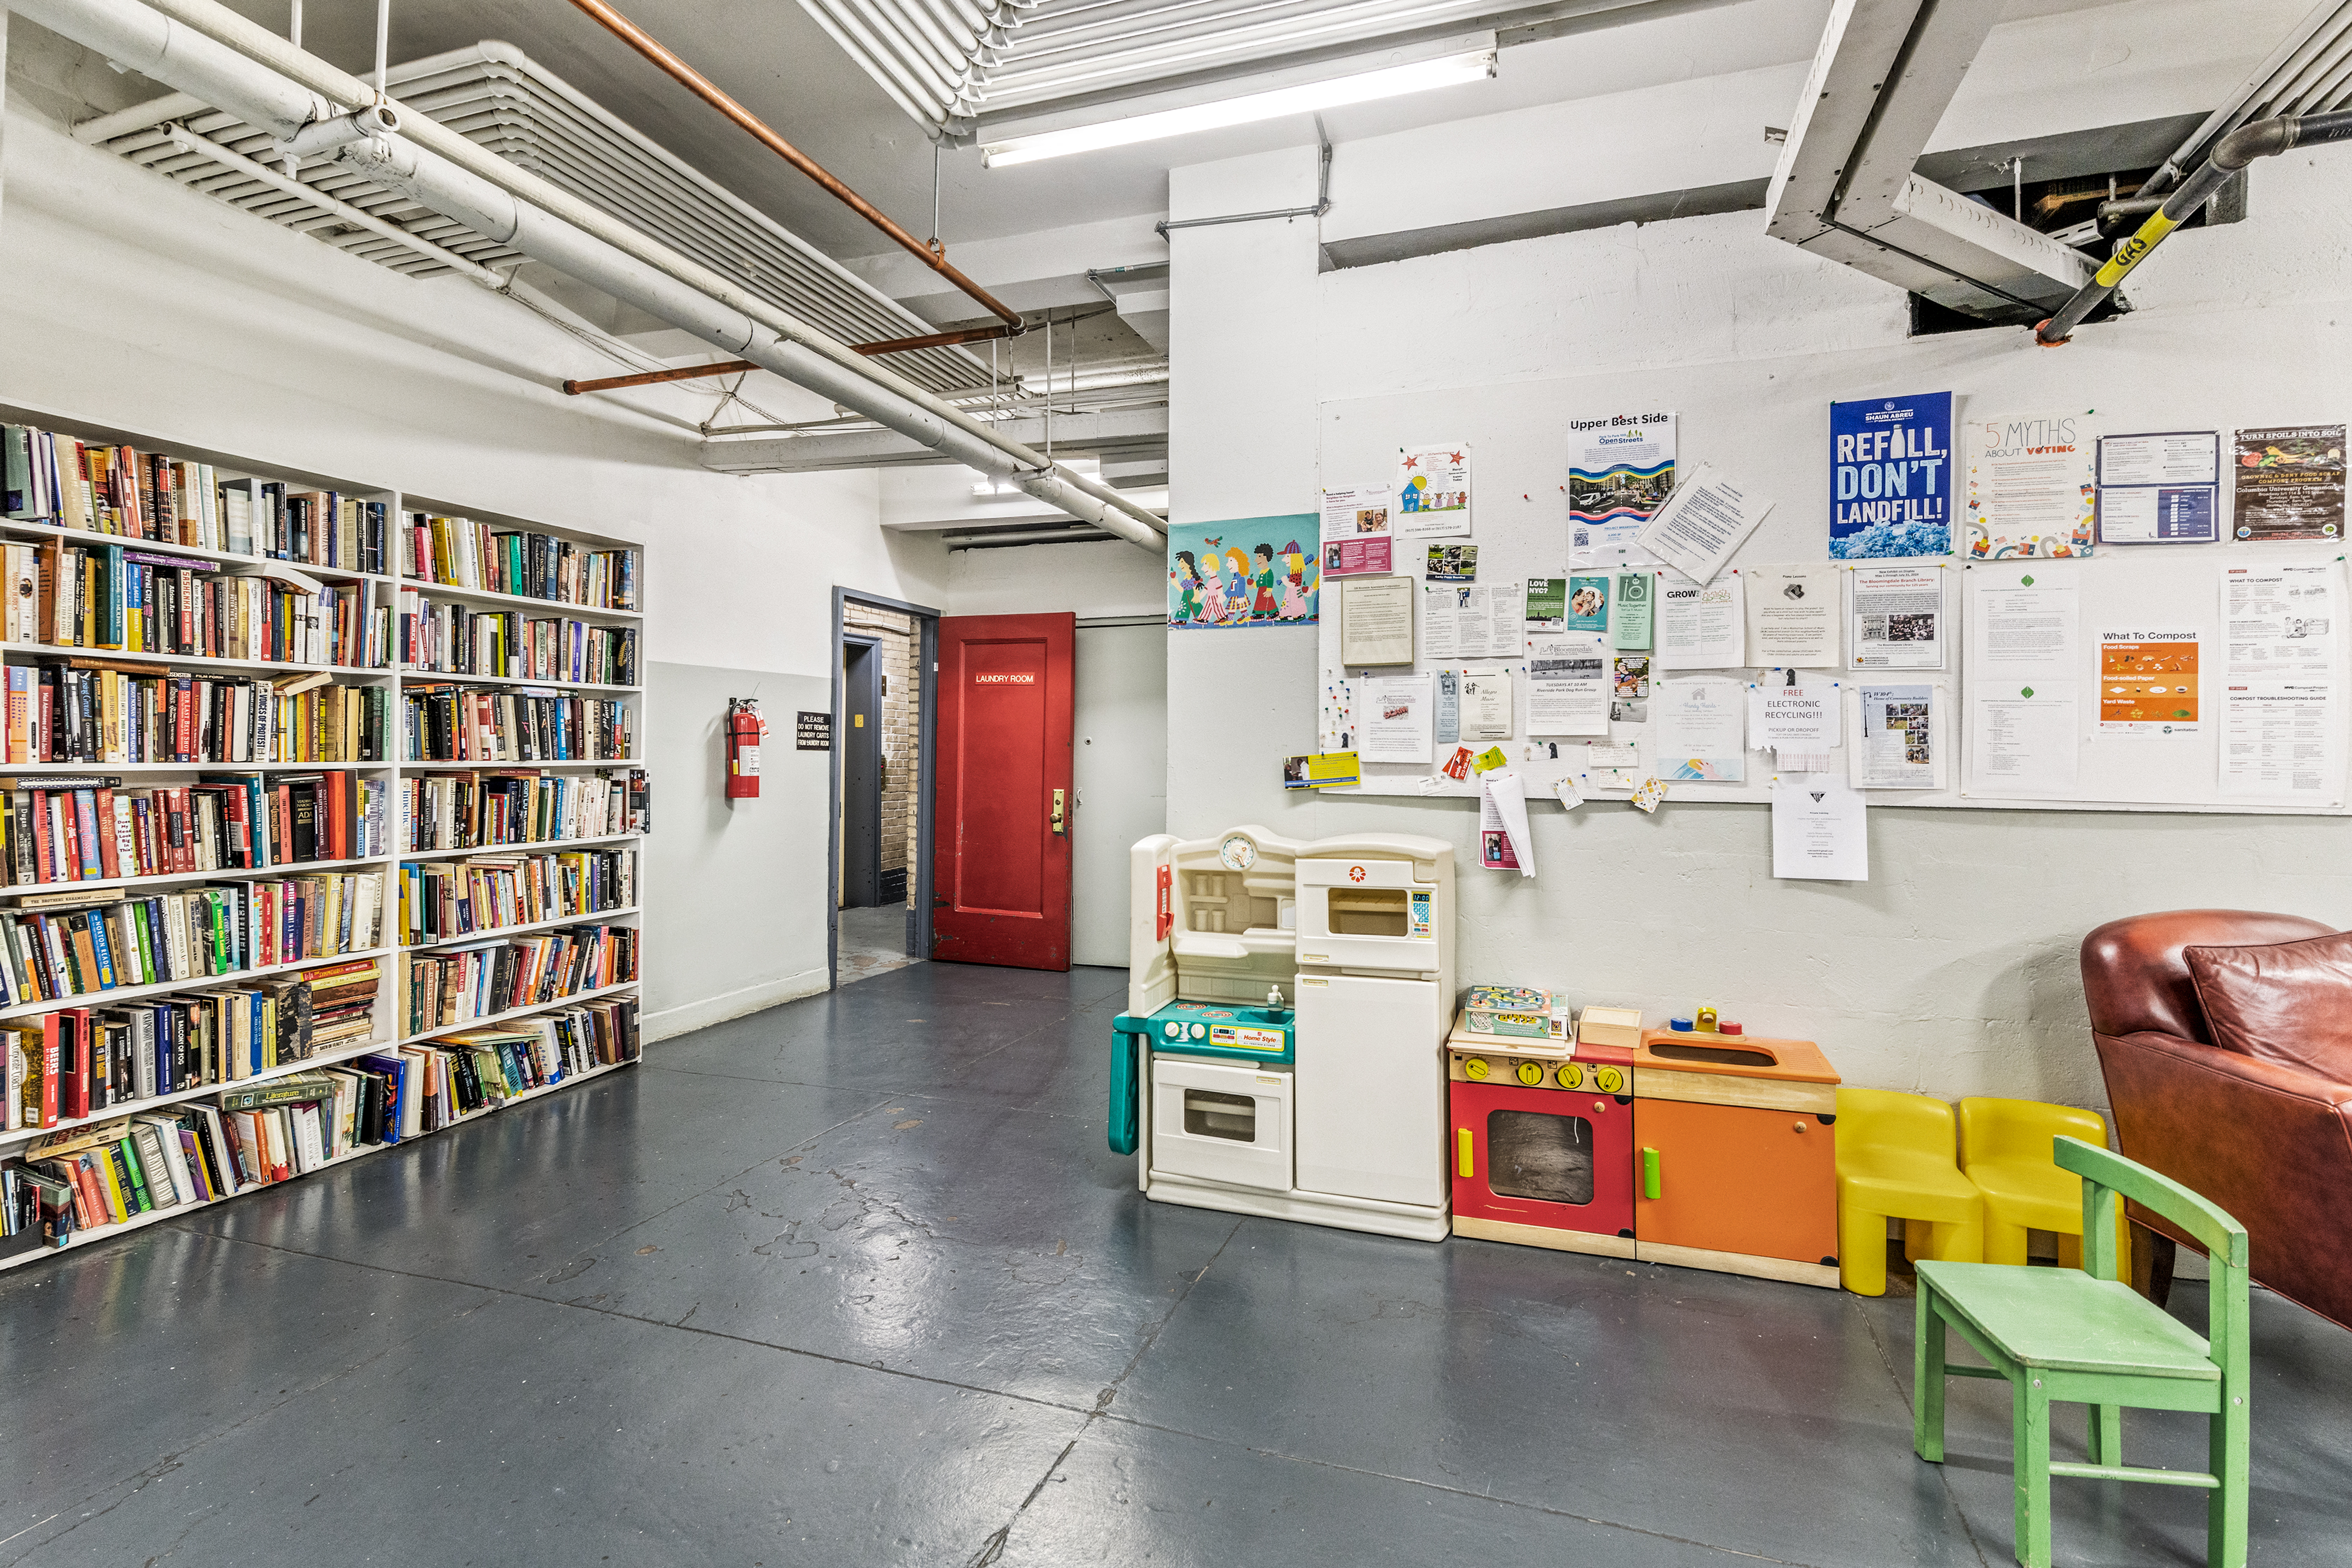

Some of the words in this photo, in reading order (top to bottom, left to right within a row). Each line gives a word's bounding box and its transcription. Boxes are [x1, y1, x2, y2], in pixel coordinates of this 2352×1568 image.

[2116, 232, 2147, 266] GAS
[1571, 420, 1608, 431] Upper
[1612, 416, 1638, 426] Best
[1642, 413, 1668, 424] Side
[1985, 423, 2000, 448] 5
[2006, 418, 2075, 447] MYTHS
[1985, 448, 2022, 458] ABOUT
[2027, 445, 2076, 455] VOTING
[94, 458, 104, 481] TSUKIJI
[1837, 498, 1942, 524] LANDFILL!
[136, 554, 167, 564] Aromatherapy
[183, 572, 191, 610] SASHENKA
[2148, 632, 2197, 641] Compost
[259, 695, 268, 714] VOICES
[1384, 706, 1408, 719] SCAM
[257, 722, 266, 749] PROTEST
[447, 780, 455, 806] headlong
[19, 808, 28, 828] Dugan
[78, 803, 92, 833] Marketing
[81, 833, 94, 860] Glossary
[95, 921, 106, 947] NORTON
[9, 1044, 20, 1072] Corporate
[50, 1046, 59, 1075] BEERS
[12, 1071, 21, 1090] Coach
[266, 1090, 299, 1100] Literature
